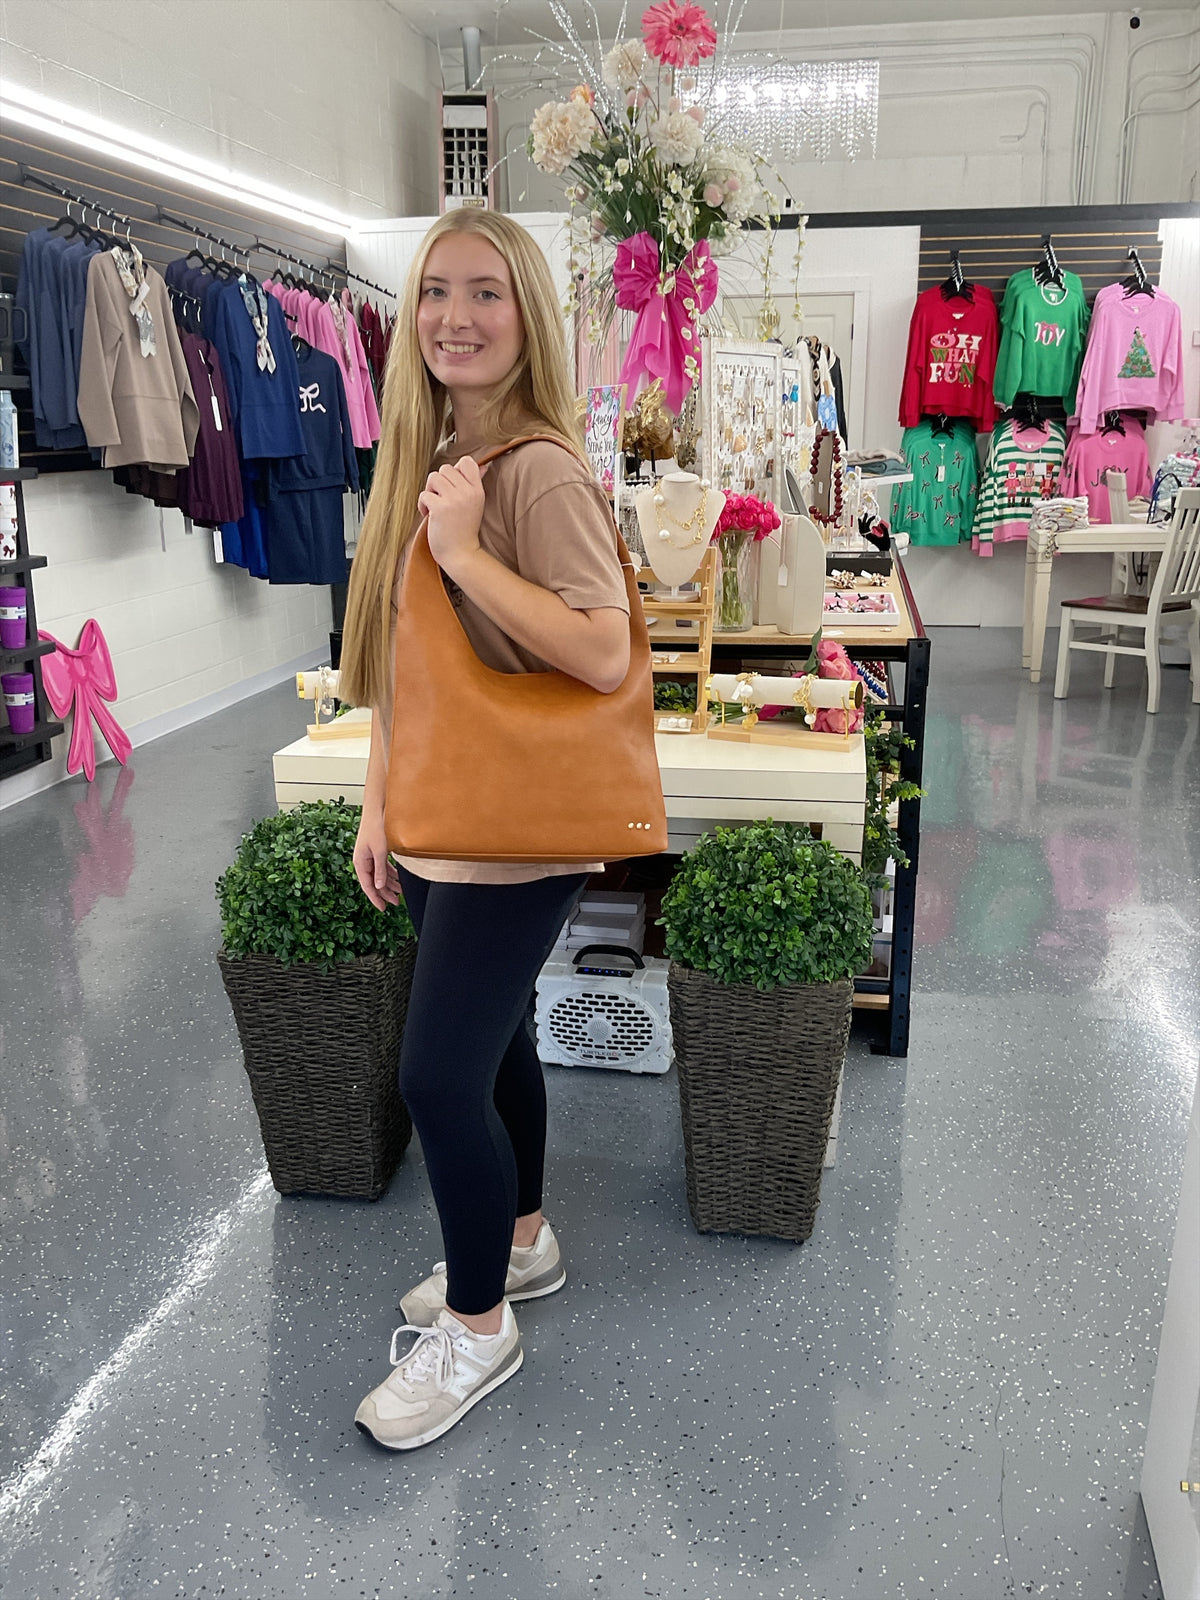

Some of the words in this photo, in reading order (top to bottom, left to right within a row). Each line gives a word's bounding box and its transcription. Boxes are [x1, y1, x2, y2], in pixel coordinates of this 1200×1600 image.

[930, 332, 982, 350] OH
[1034, 321, 1066, 347] JOY
[930, 348, 979, 364] WHAT
[929, 362, 976, 384] FUN
